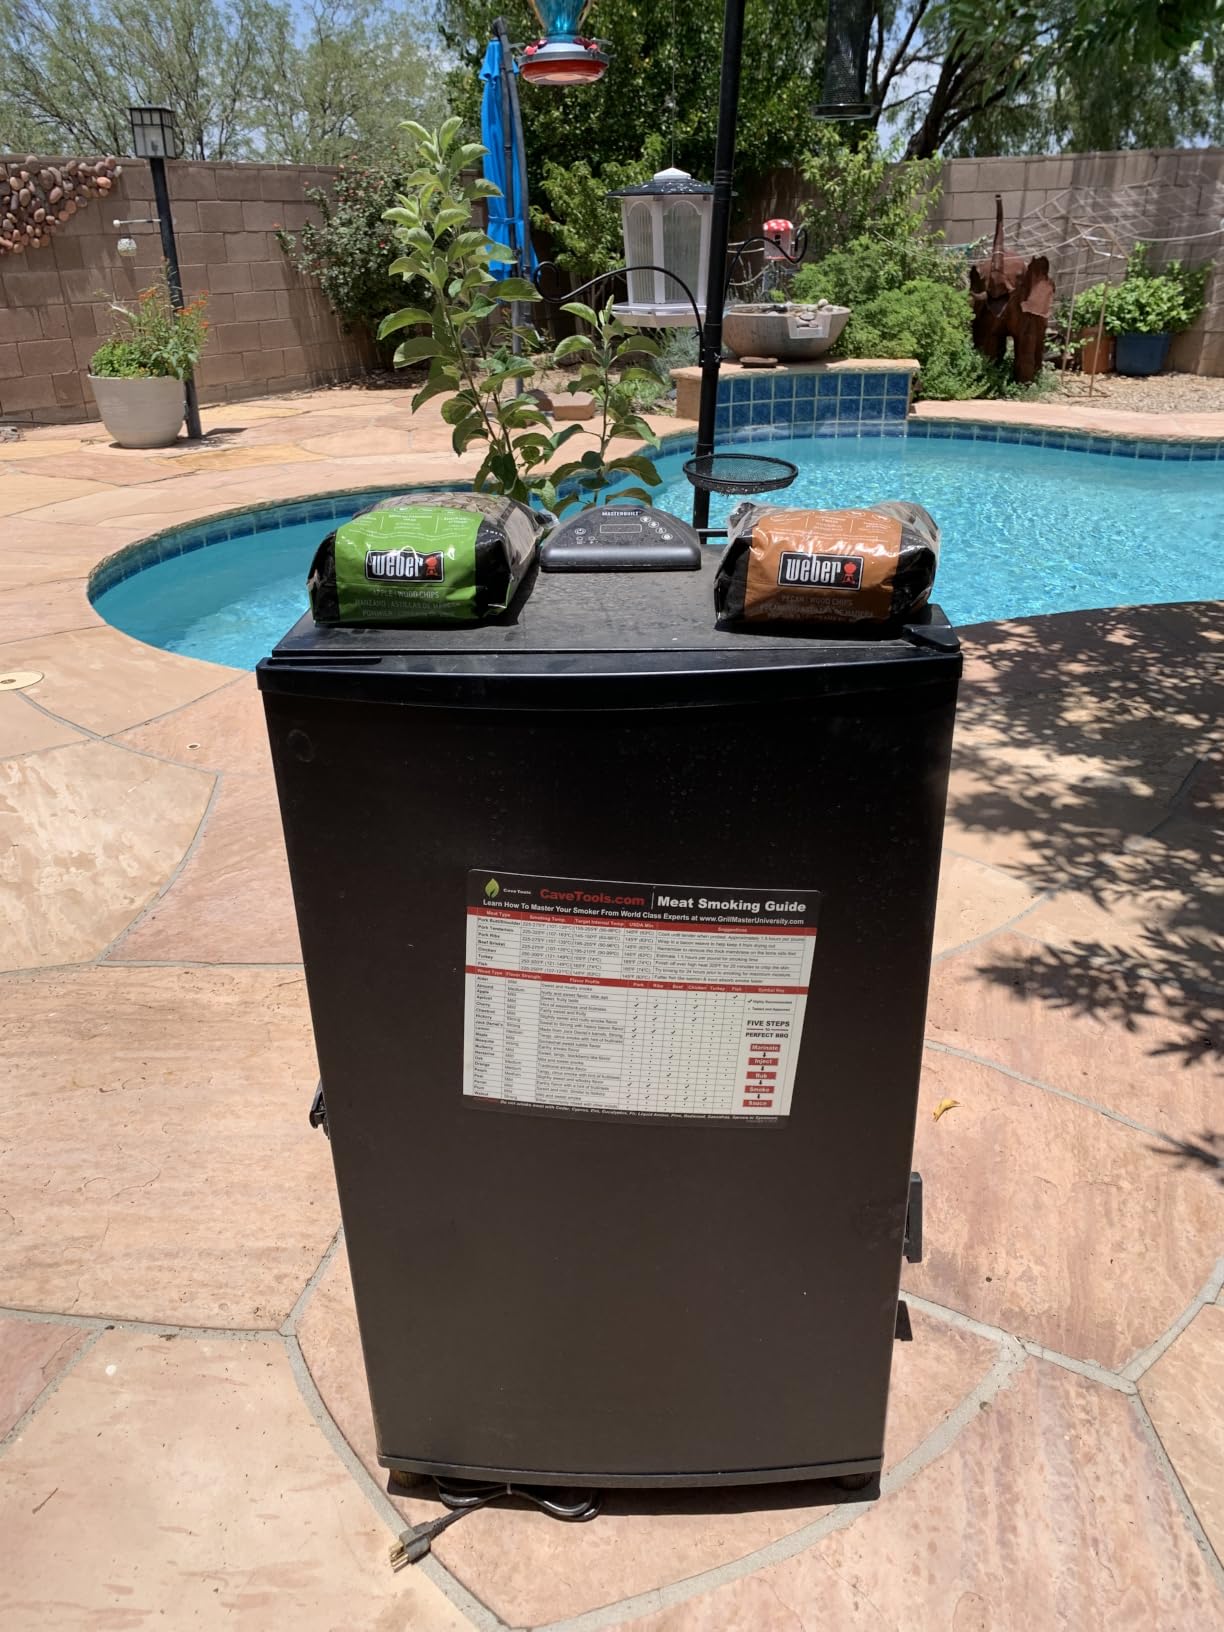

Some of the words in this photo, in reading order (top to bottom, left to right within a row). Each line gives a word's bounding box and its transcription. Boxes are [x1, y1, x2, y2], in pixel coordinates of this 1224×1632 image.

[372, 552, 424, 577] weber
[785, 556, 841, 583] weber
[398, 590, 417, 598] WOOD
[419, 591, 439, 599] CHIPS
[539, 888, 645, 906] CaveTools.com
[657, 896, 694, 909] Meat
[698, 897, 760, 913] Smoking
[765, 900, 807, 913] Guide
[483, 898, 502, 908] Learn
[504, 901, 519, 909] How
[521, 902, 529, 910] To
[531, 904, 554, 912] Master
[555, 905, 572, 913] Your
[573, 907, 599, 915] Smoker
[601, 909, 619, 917] From
[621, 910, 641, 918] World
[663, 913, 689, 922] Experts
[700, 915, 804, 926] www.GrillMasterUniversity.com
